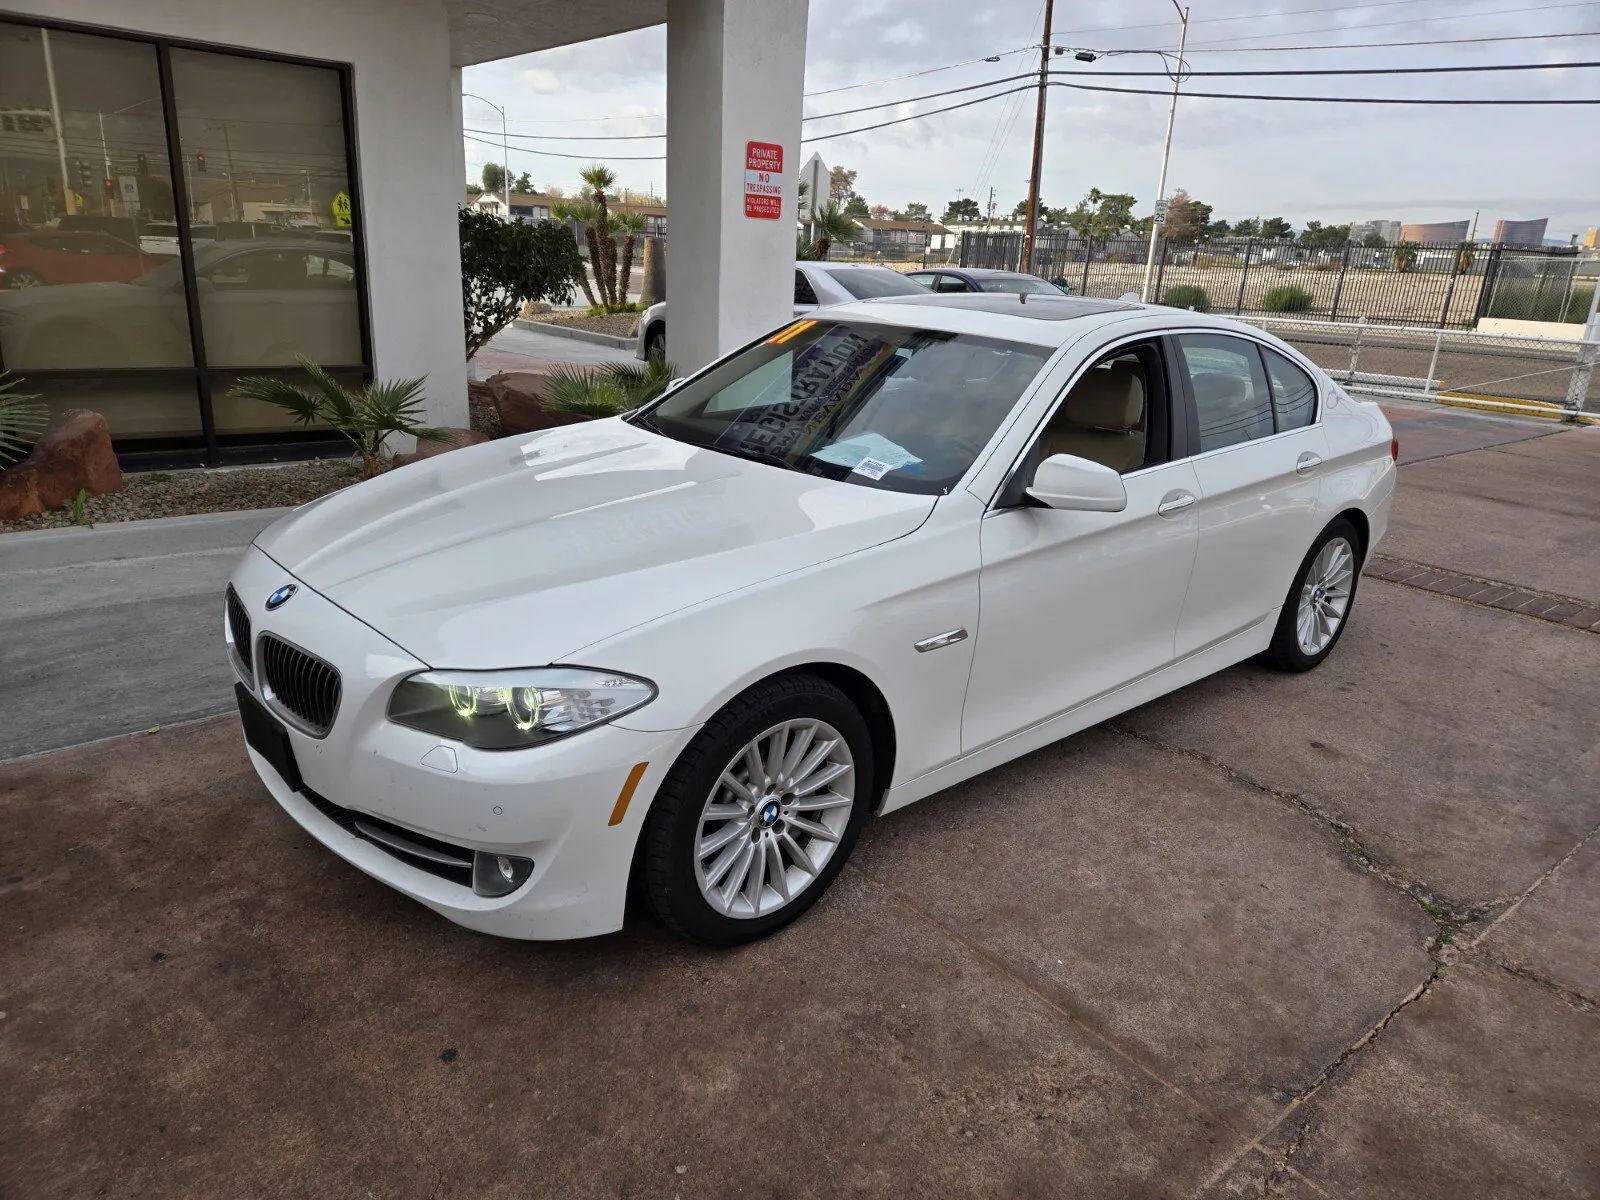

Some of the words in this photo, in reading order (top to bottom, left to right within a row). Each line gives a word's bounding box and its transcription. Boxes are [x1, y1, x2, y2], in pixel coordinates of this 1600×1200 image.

[752, 148, 777, 160] PRIVATE
[748, 158, 780, 170] PROPERTY
[758, 173, 770, 182] NO
[746, 182, 781, 194] TRESPASSING
[1154, 212, 1165, 223] 25
